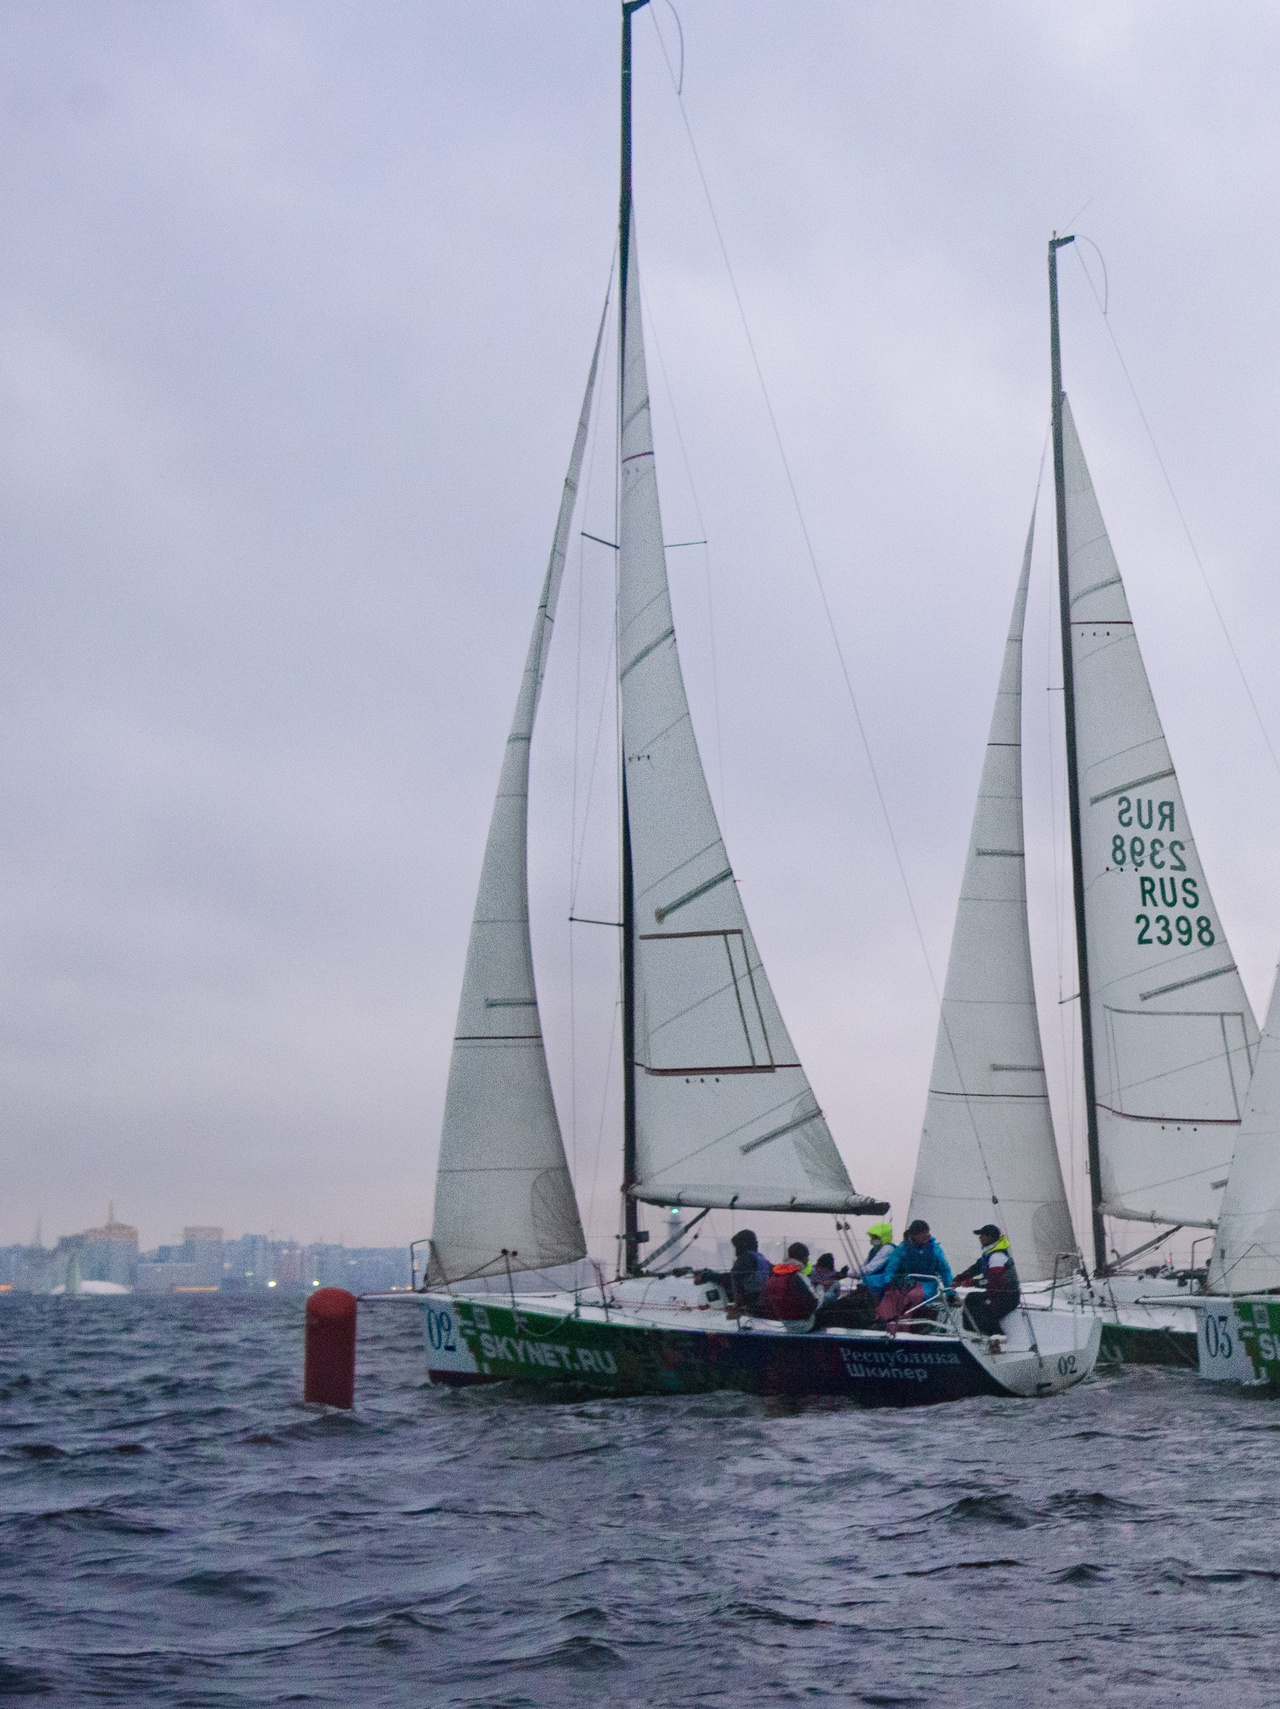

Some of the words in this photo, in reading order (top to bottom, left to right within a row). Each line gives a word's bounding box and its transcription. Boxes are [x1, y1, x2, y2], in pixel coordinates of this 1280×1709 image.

[1140, 876, 1199, 909] RUS
[1135, 913, 1215, 947] 2398
[427, 1308, 456, 1351] 02
[1205, 1314, 1233, 1359] 03
[480, 1333, 618, 1375] SKYNET.RU
[840, 1346, 961, 1371] Республика
[1058, 1354, 1077, 1376] 02
[846, 1363, 928, 1382] Шкипер
